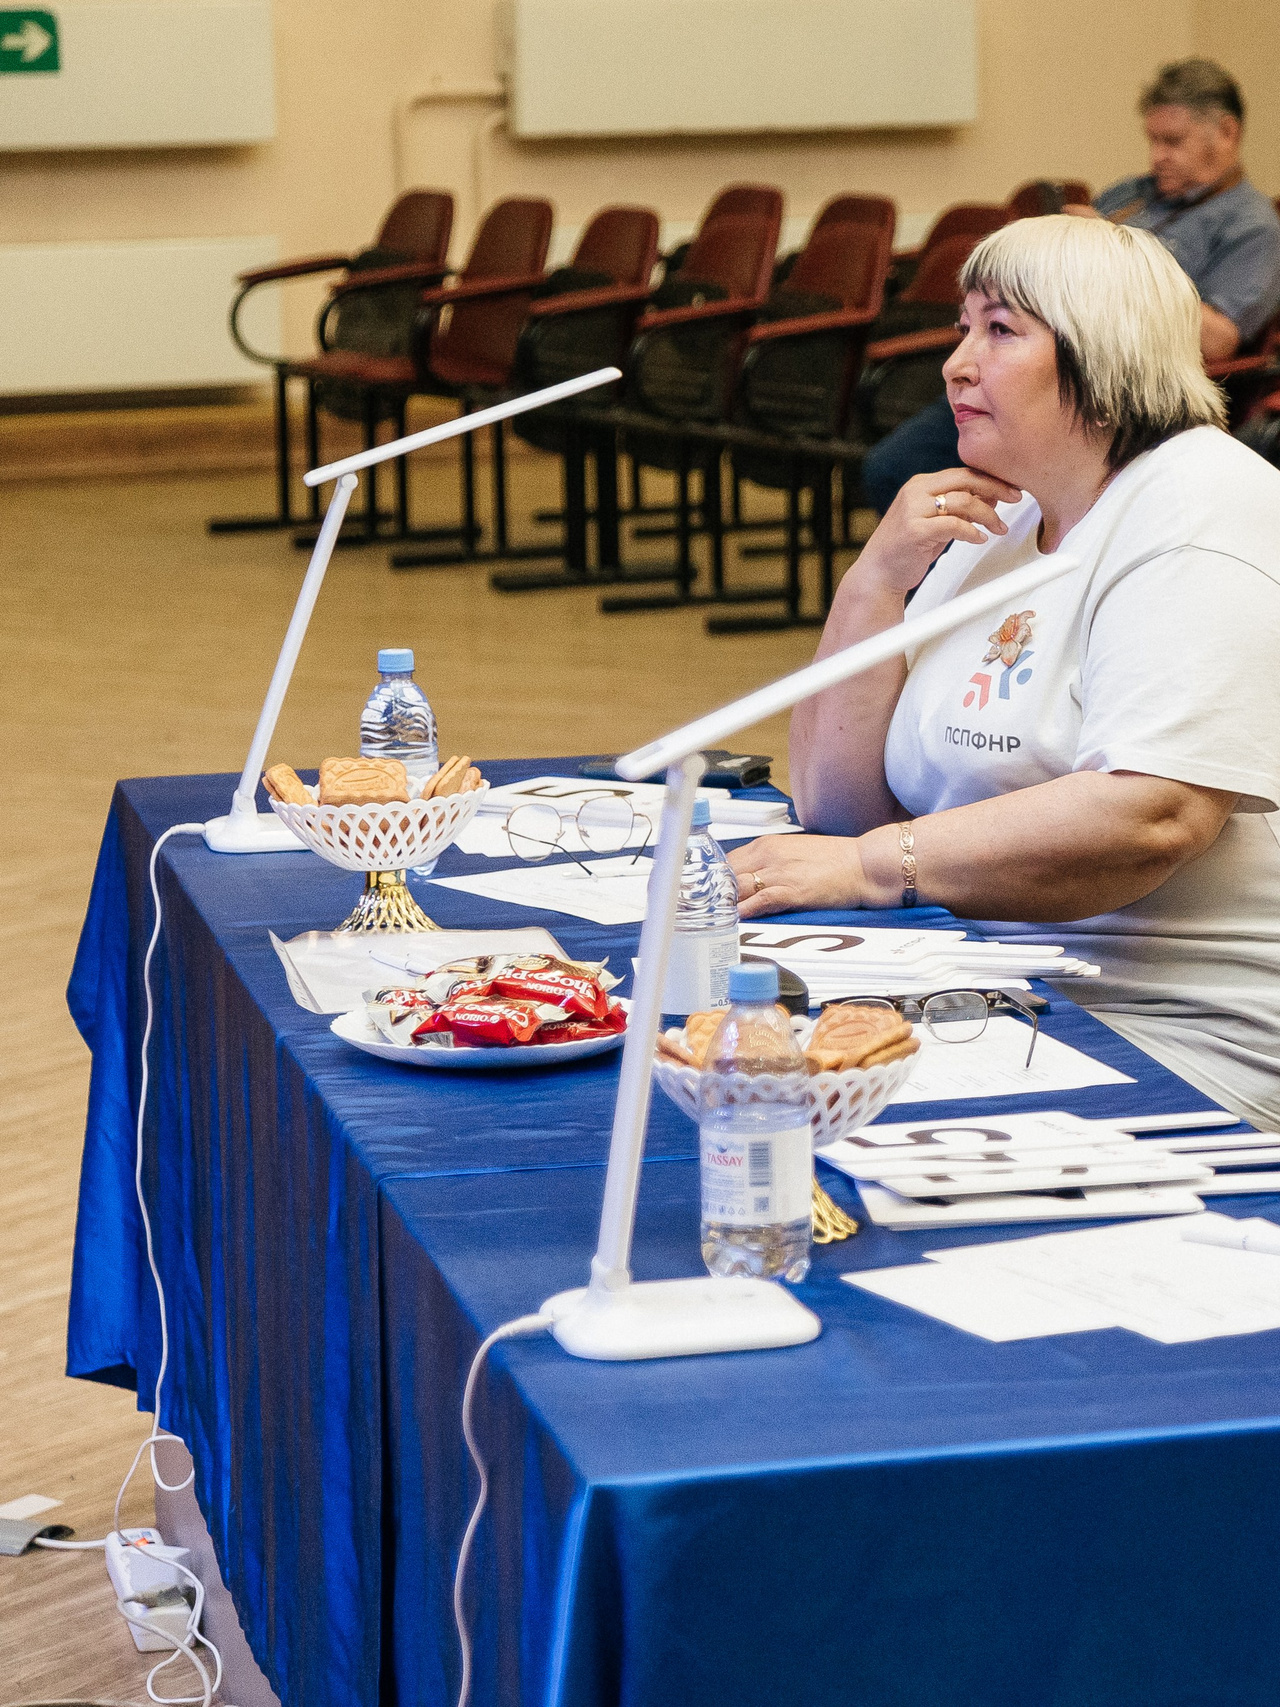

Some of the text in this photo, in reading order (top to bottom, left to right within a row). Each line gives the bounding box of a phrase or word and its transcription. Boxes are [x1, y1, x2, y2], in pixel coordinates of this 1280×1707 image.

[944, 725, 1021, 753] ПСПФНР
[454, 1013, 488, 1023] ORION
[707, 1153, 743, 1167] TASSAY
